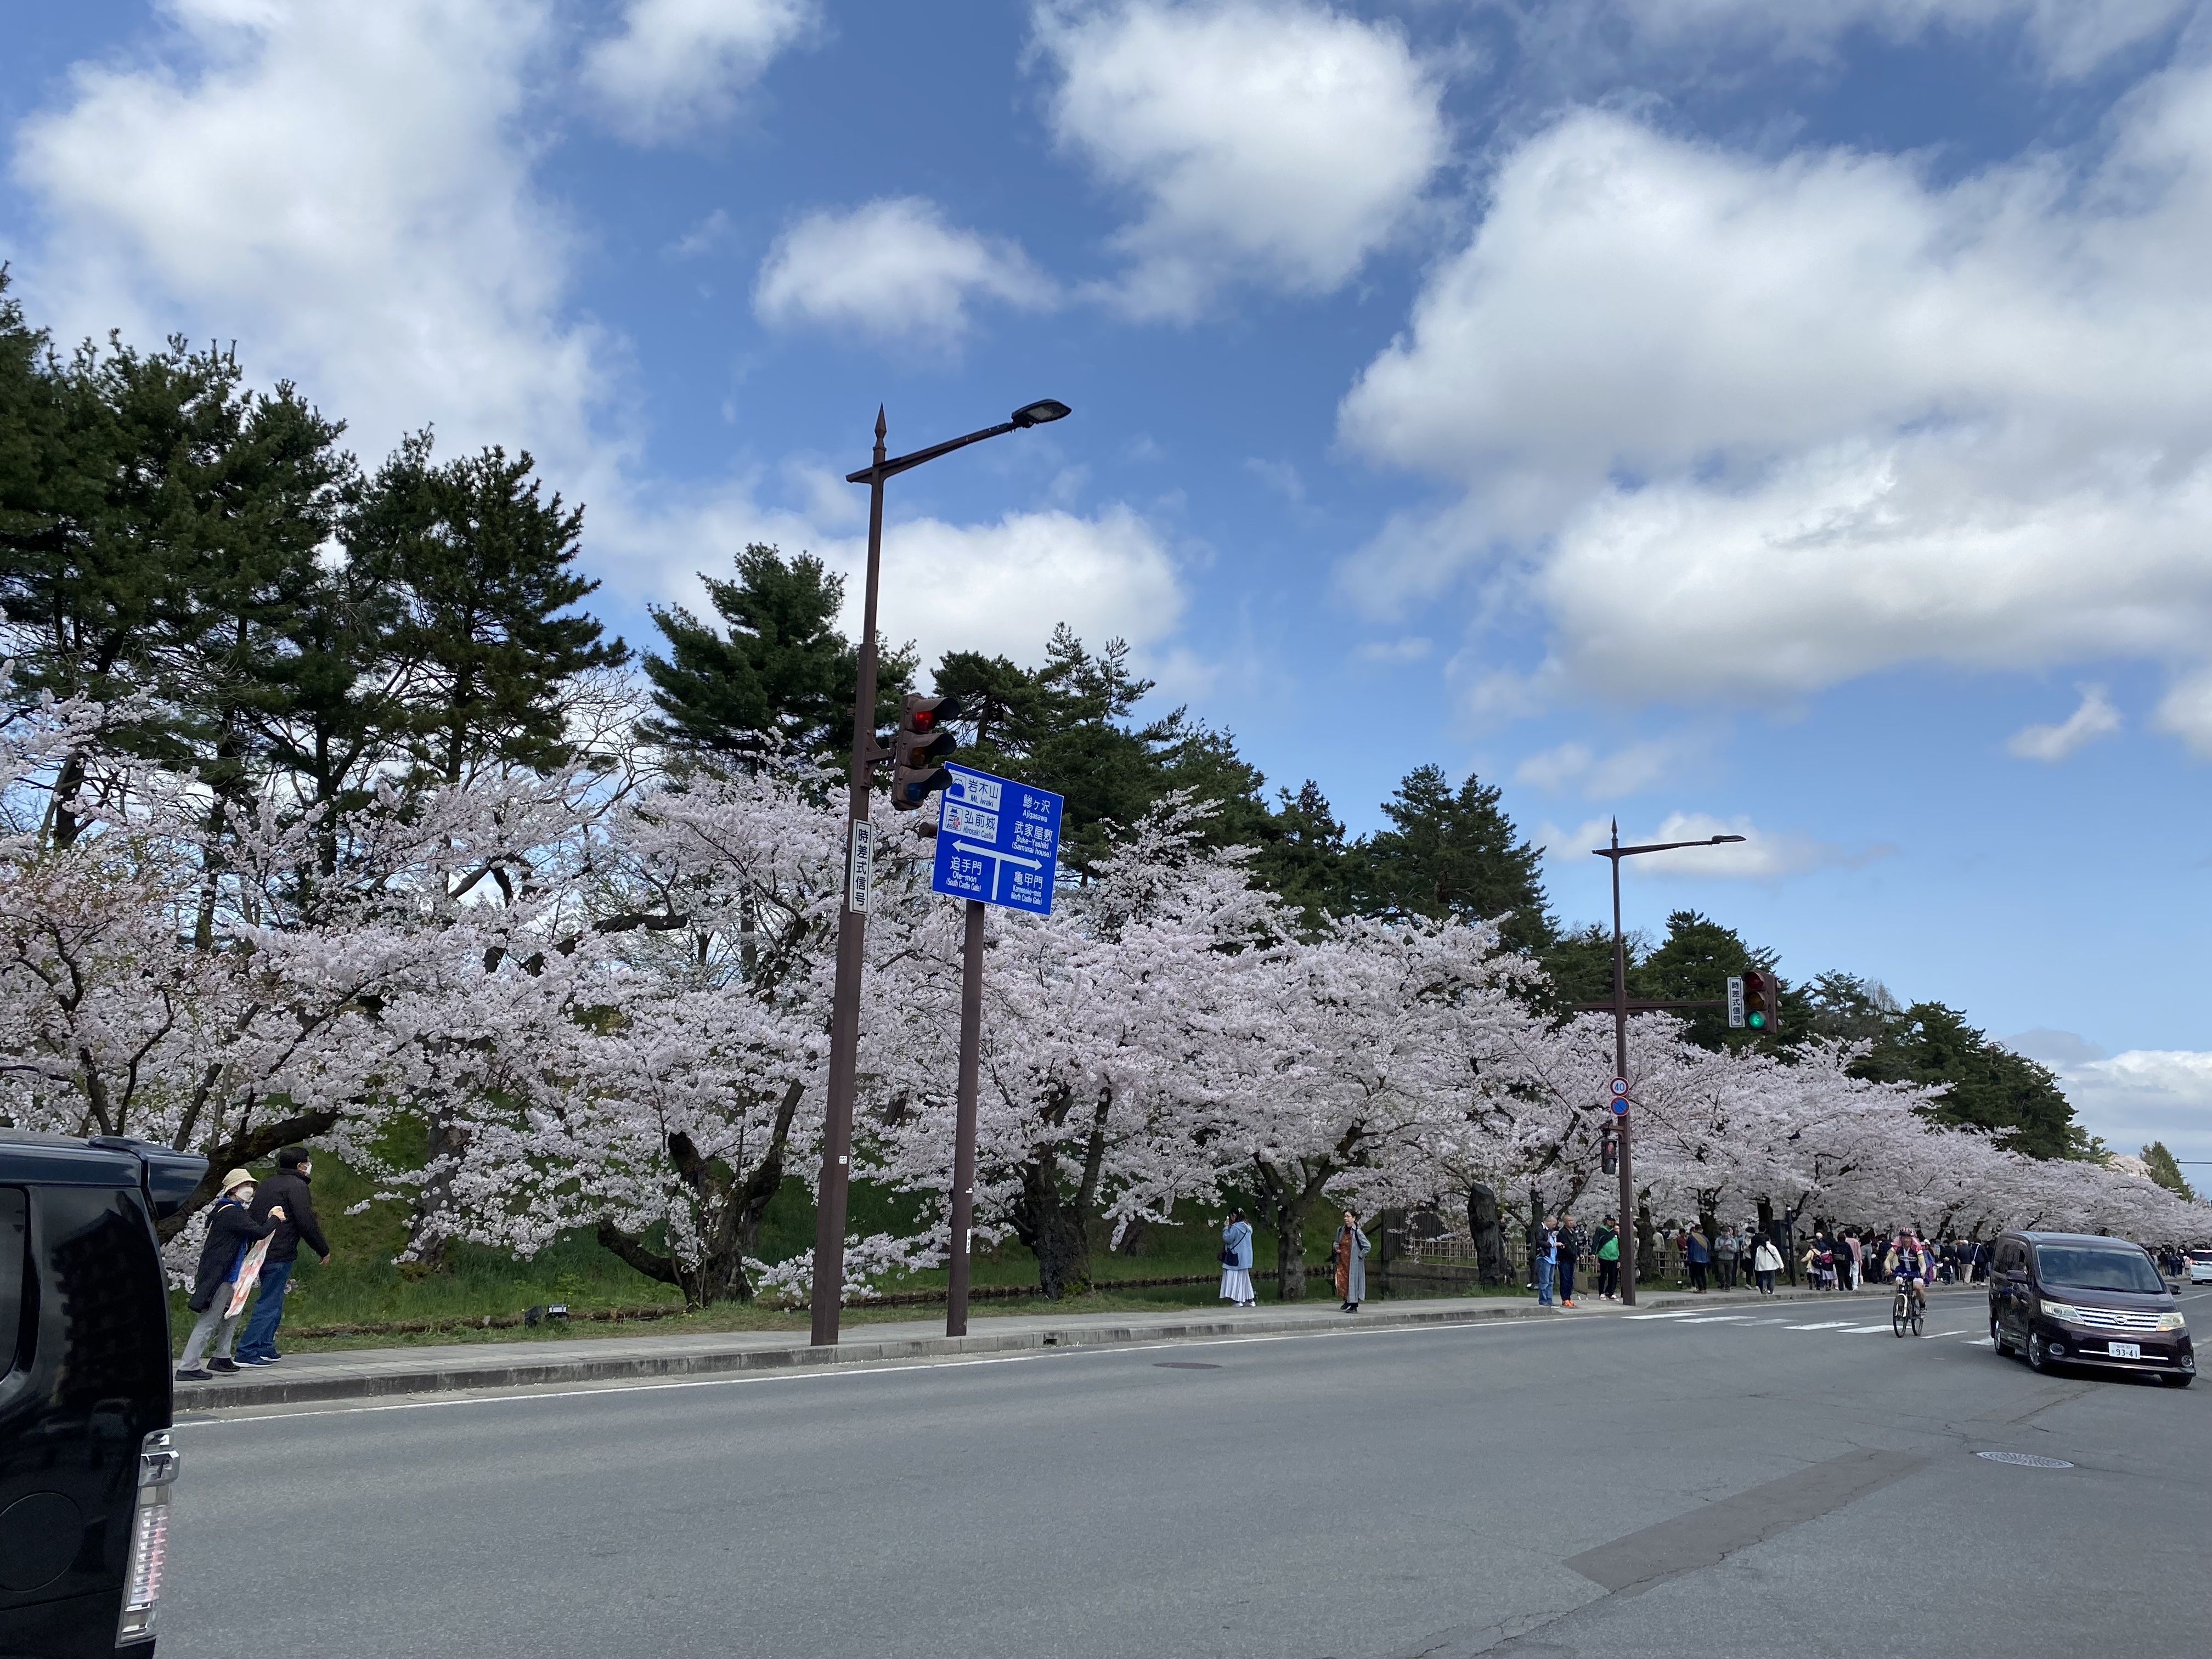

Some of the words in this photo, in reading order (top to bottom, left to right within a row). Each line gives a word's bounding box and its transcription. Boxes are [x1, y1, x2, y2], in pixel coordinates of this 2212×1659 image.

[968, 778, 998, 799] 岩木山
[980, 797, 994, 807] Iwaki
[964, 810, 995, 831] 弘前城
[1023, 809, 1047, 822] Ajigasawa
[963, 826, 980, 836] Hirosaki
[981, 831, 994, 840] Castle
[1014, 821, 1053, 843] 武家屋敷
[1016, 834, 1049, 849] Buke-Yashiki
[1012, 842, 1034, 854] (Samurai
[1035, 848, 1051, 858] house)
[855, 829, 868, 906] 時差式信号
[950, 856, 982, 875] 追手門
[952, 871, 977, 883] Ote-mon
[1014, 871, 1043, 889] 亀甲門
[1615, 1082, 1625, 1091] 40
[2116, 1348, 2137, 1357] 93-41
